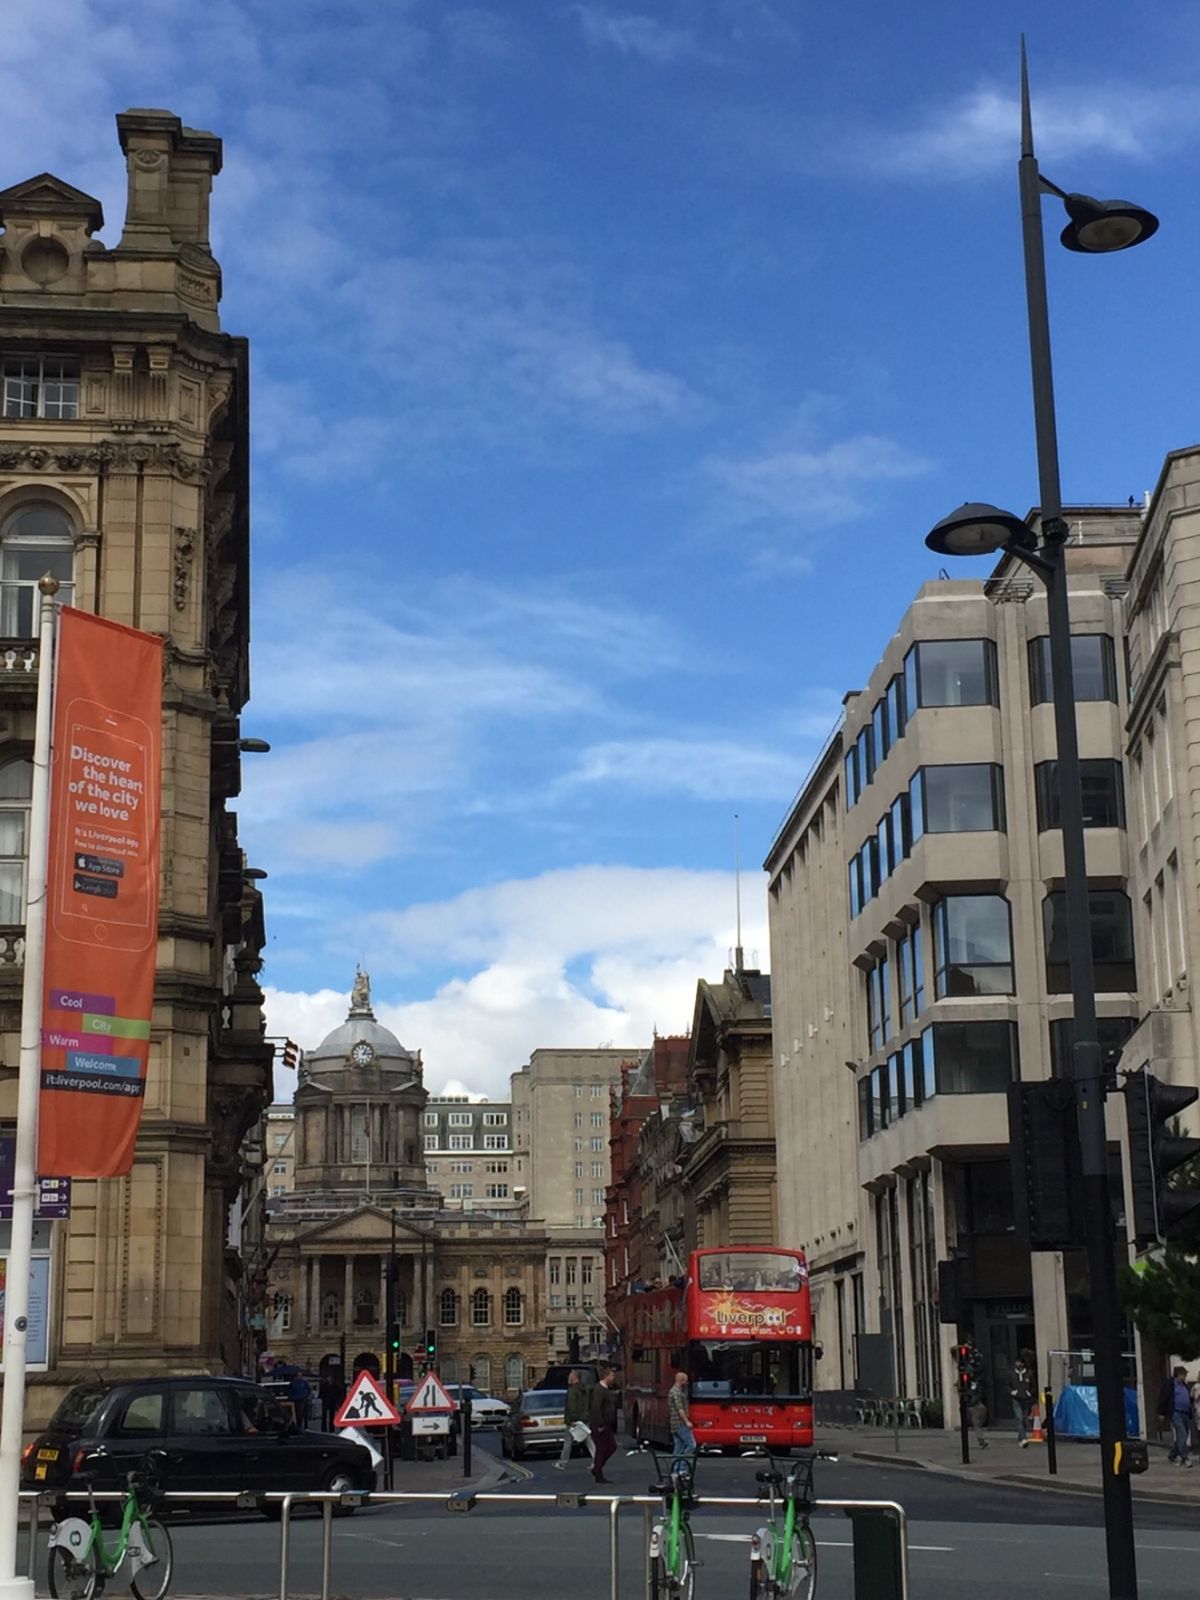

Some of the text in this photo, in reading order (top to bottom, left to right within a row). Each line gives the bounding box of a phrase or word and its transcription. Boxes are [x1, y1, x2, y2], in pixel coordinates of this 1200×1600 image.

[71, 745, 132, 772] Discover
[83, 765, 143, 794] the heart
[68, 781, 139, 811] of the city
[75, 800, 129, 820] we love
[60, 995, 83, 1008] Cool
[91, 1018, 112, 1033] City
[49, 1034, 79, 1047] Warm
[74, 1056, 117, 1071] Welcome
[716, 1306, 787, 1327] Liverpool
